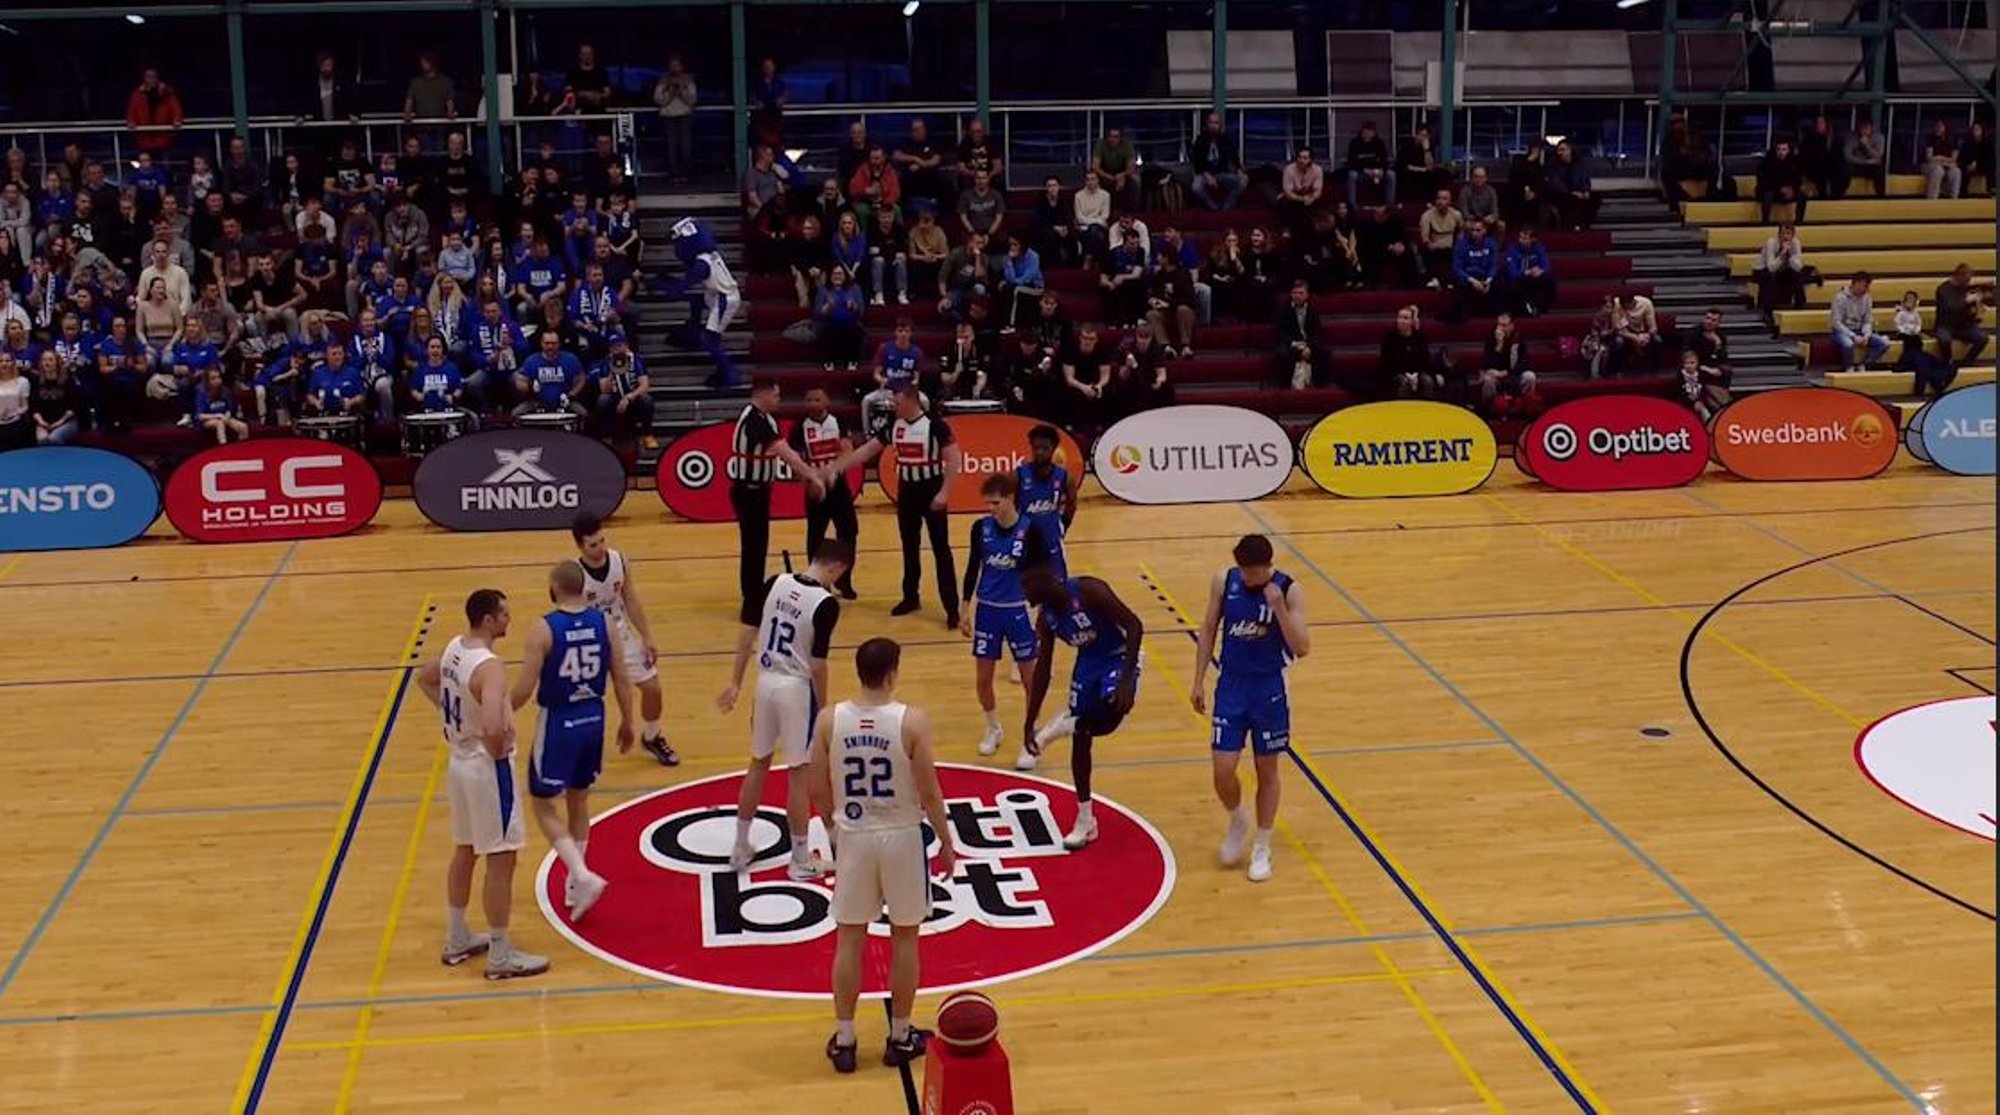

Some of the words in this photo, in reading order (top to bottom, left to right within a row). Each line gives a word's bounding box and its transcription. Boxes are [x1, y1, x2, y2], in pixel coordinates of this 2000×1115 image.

[1588, 426, 1692, 460] Optibet
[1727, 421, 1848, 445] Swedbank
[1149, 443, 1279, 472] UTILITAS
[1333, 439, 1474, 467] RAMIRENT
[461, 484, 579, 511] FINNLOG
[202, 501, 347, 522] HOLDING
[1012, 540, 1024, 557] 2
[1258, 603, 1273, 625] 11
[768, 616, 797, 657] 12
[976, 639, 988, 655] 2
[558, 643, 601, 684] 45
[844, 756, 896, 797] 22
